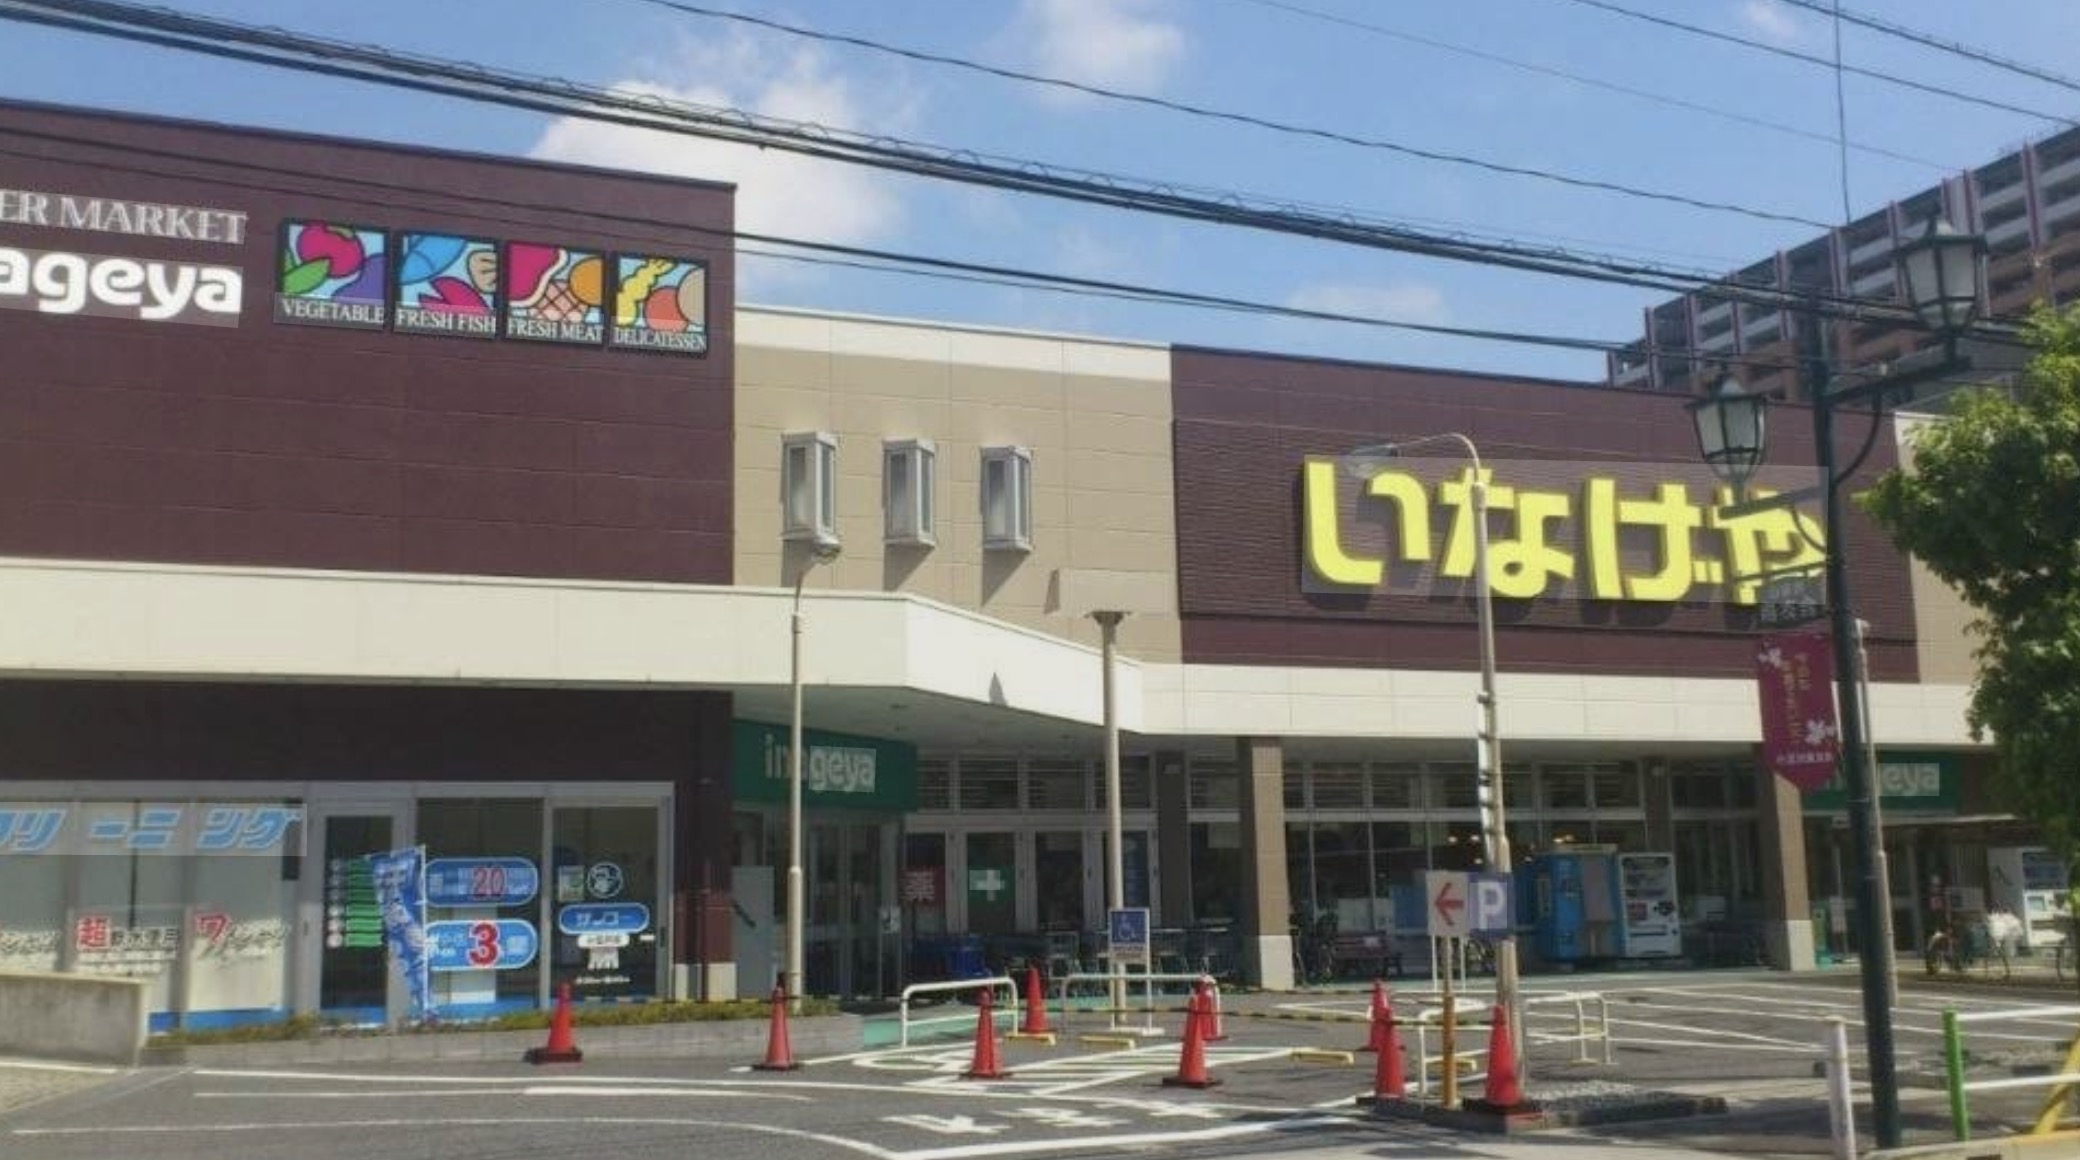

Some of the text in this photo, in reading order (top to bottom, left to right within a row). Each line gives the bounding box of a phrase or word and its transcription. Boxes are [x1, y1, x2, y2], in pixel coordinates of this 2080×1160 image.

[60, 197, 248, 244] MARKET
[282, 299, 385, 324] VEGETABLE
[397, 309, 496, 332] FRESH FISH
[508, 320, 604, 341] FRESH MEAT
[614, 326, 707, 350] DELICATESSEN
[1306, 462, 1828, 606] いなげや
[1478, 881, 1505, 931] P
[468, 921, 499, 966] 3
